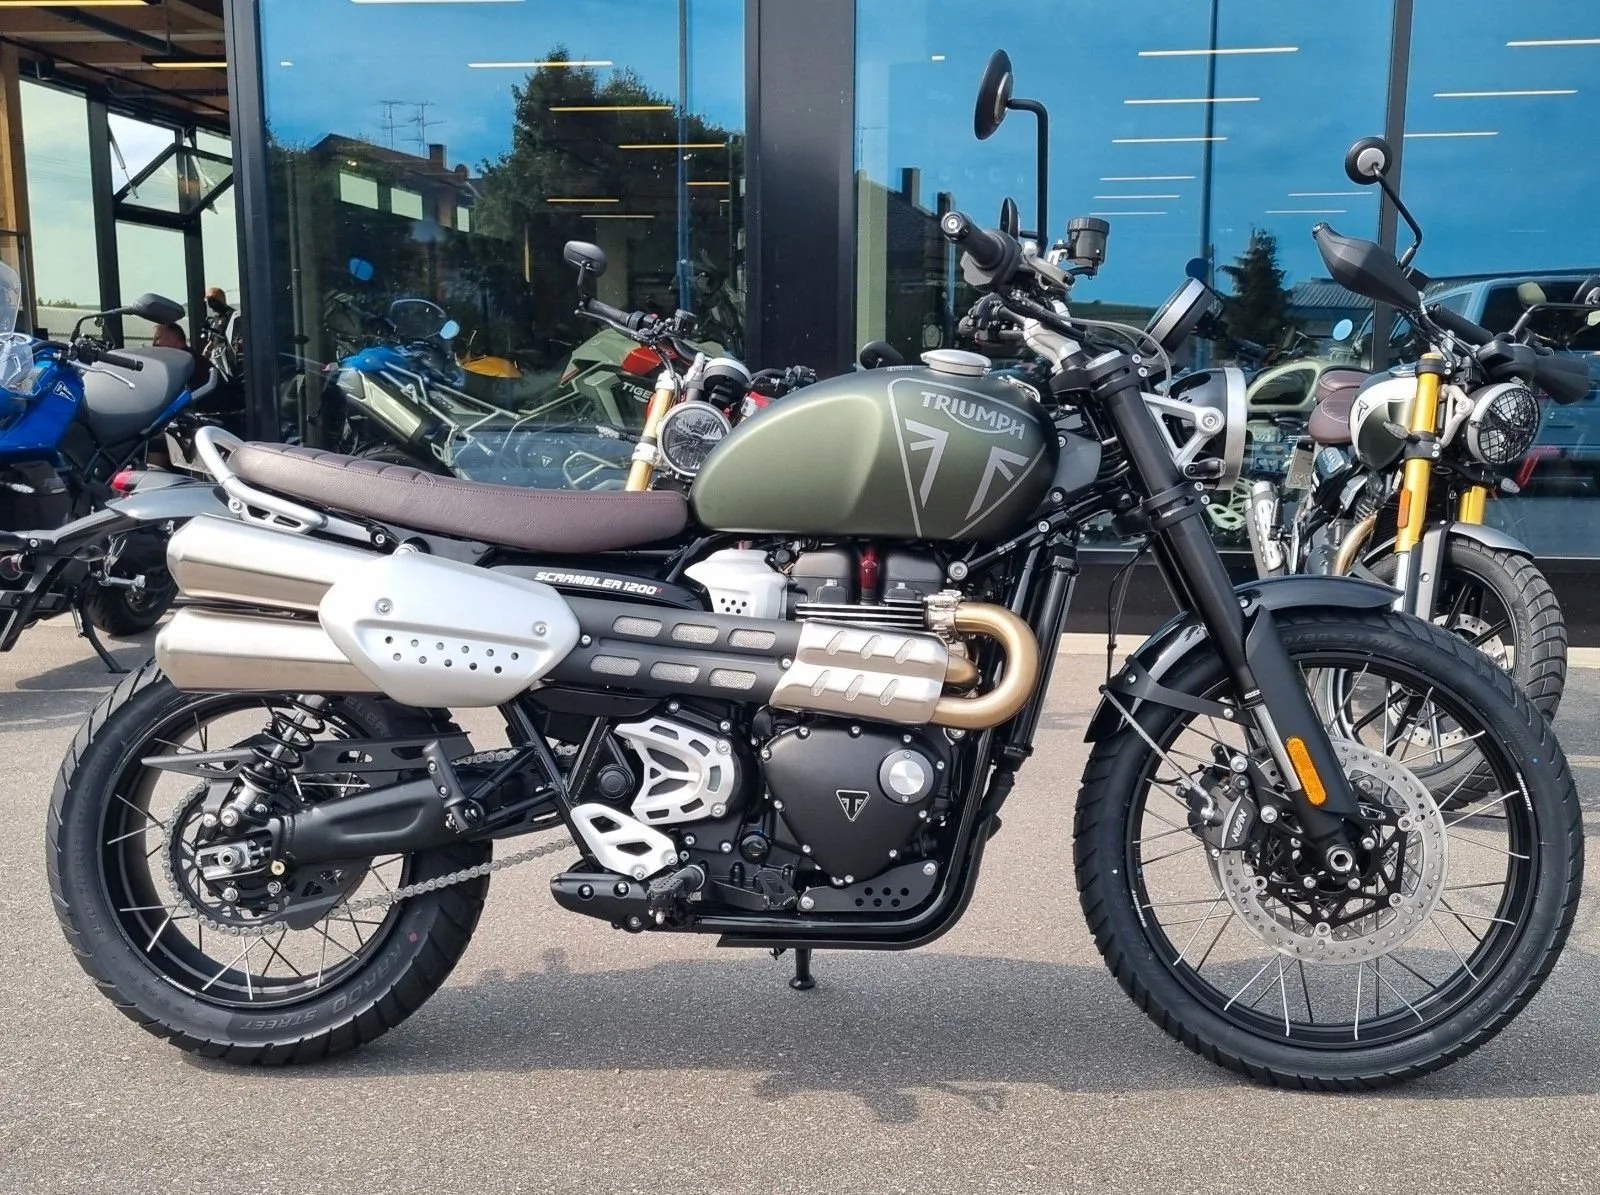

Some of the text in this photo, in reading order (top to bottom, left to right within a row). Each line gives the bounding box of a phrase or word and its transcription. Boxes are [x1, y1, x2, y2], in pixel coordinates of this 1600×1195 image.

[622, 381, 654, 400] TIGE
[920, 391, 1025, 440] TRIUMPH
[534, 571, 622, 590] SCRAMBLER
[239, 944, 403, 1030] KAROO STREET
